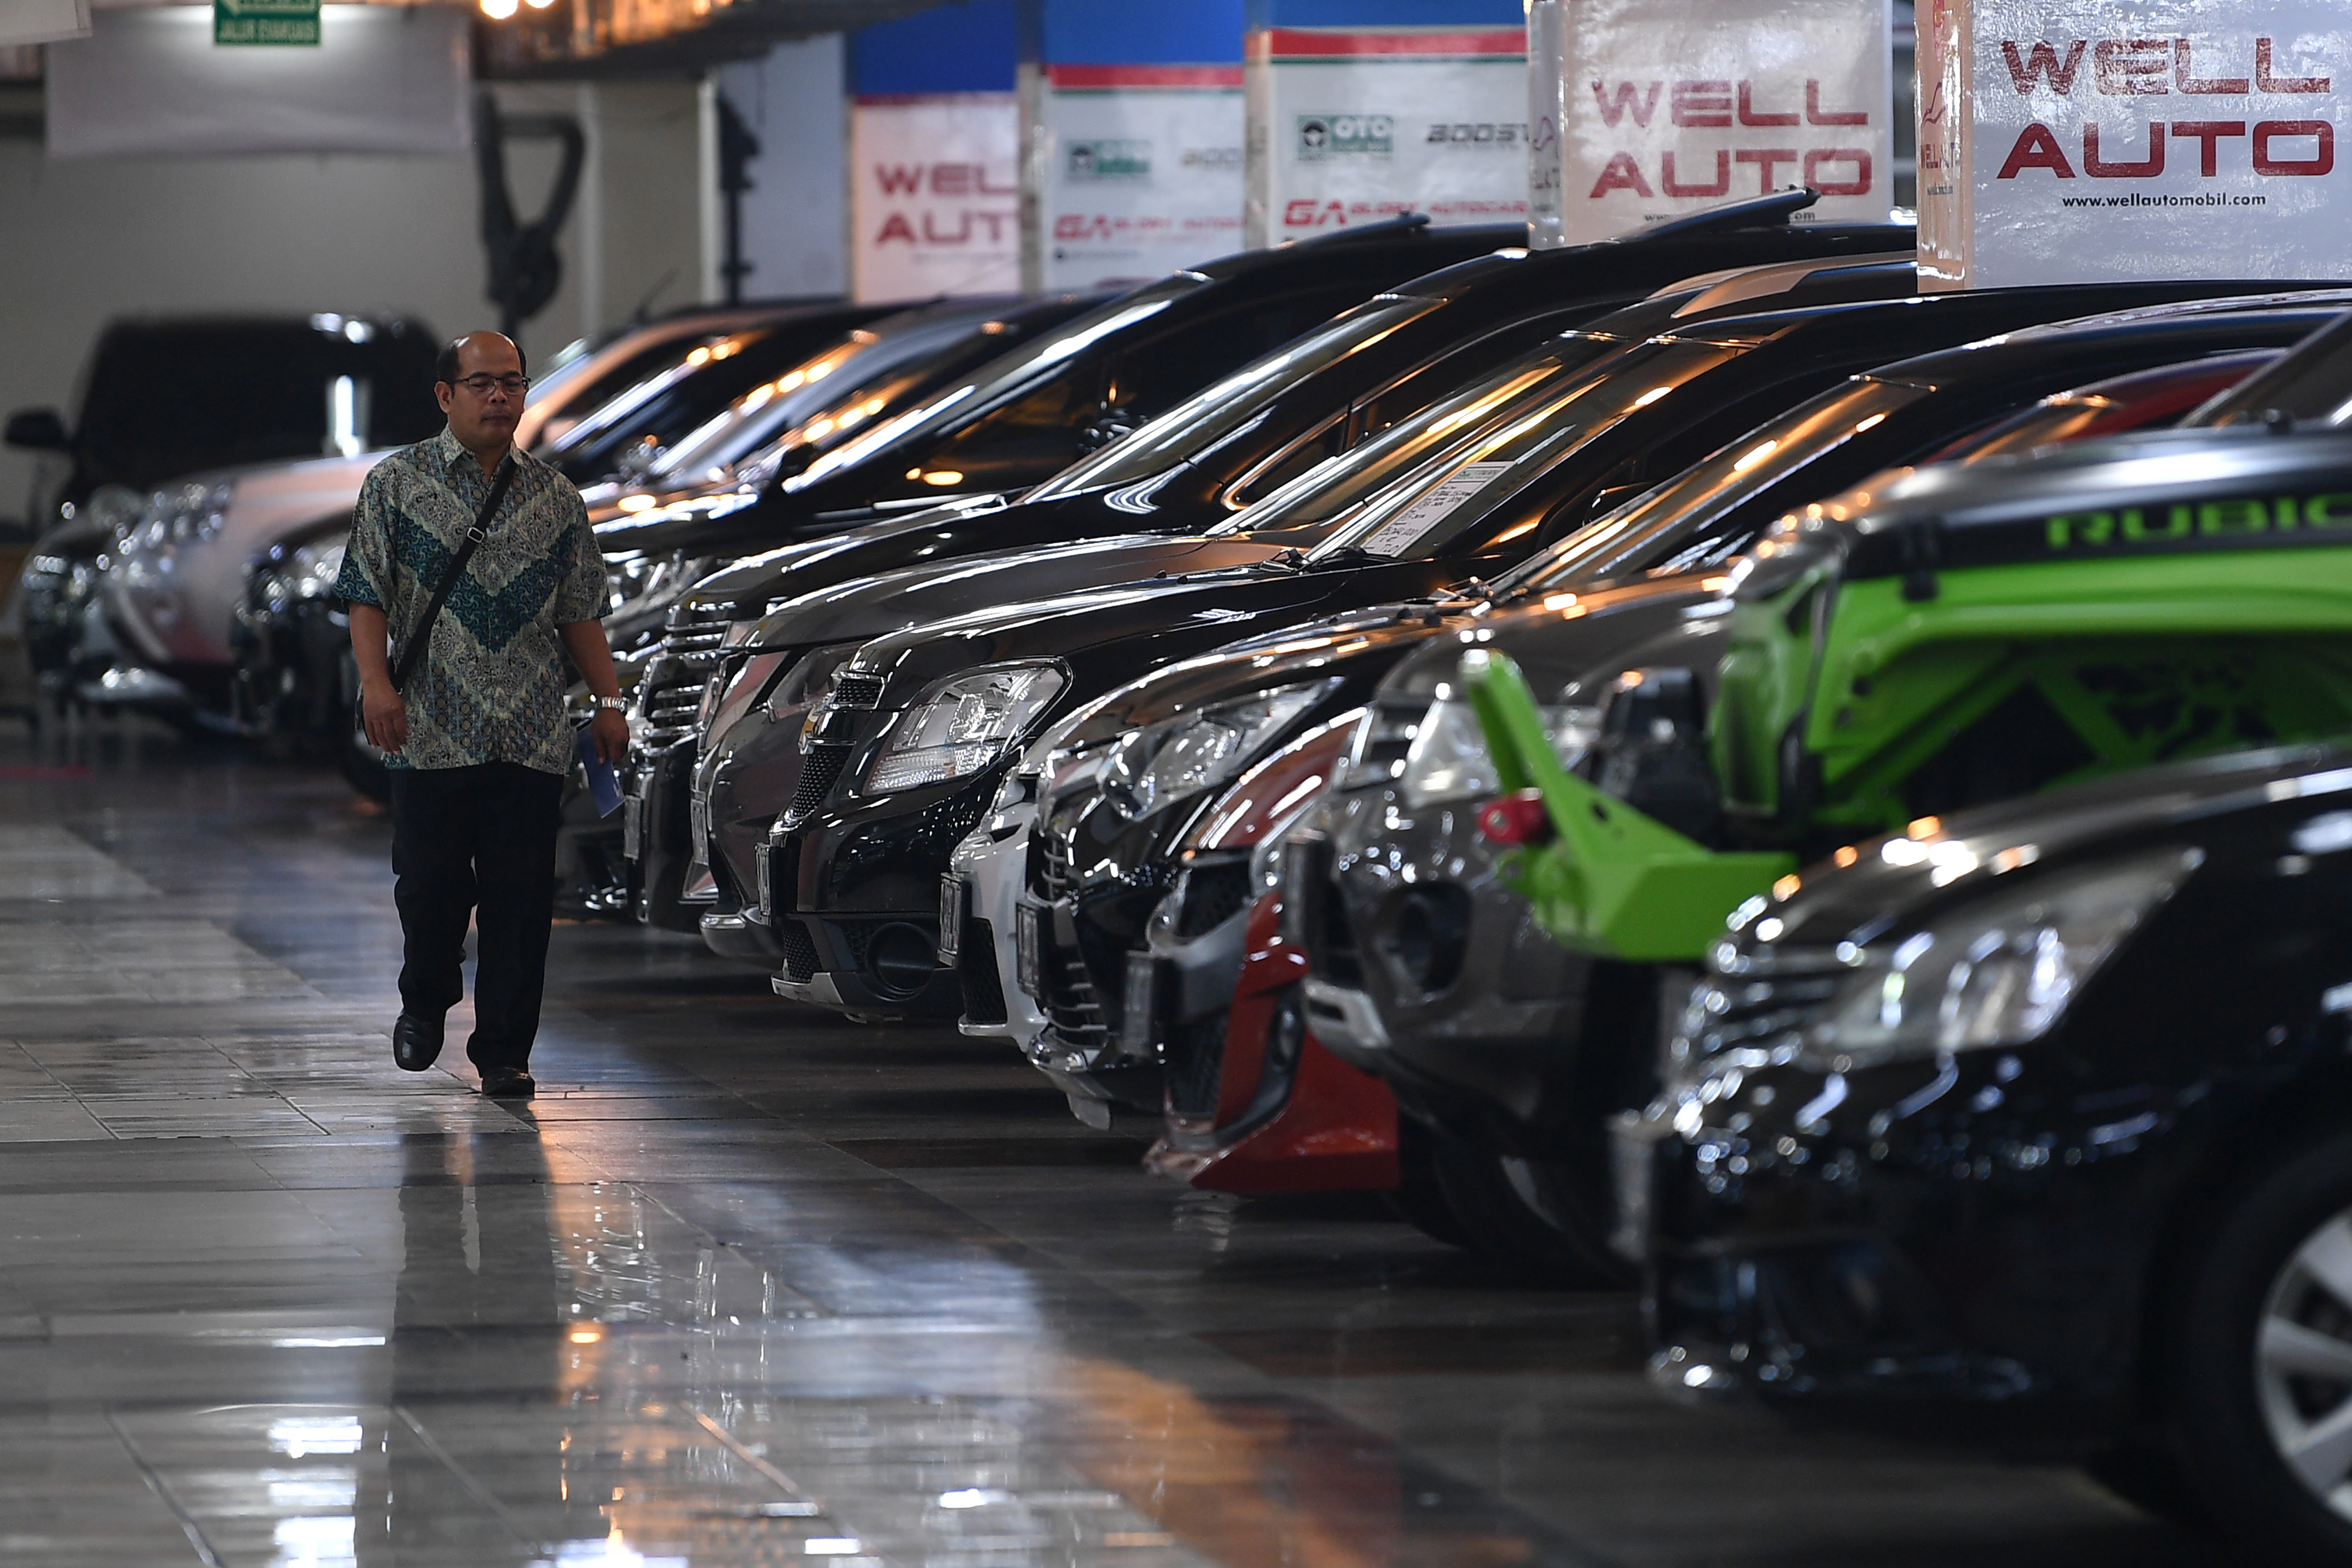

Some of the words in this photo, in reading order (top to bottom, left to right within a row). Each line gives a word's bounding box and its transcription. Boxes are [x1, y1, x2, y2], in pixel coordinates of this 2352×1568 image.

[2004, 37, 2331, 95] WELL
[1591, 79, 1869, 128] WELL
[1589, 148, 1872, 199] AUTO
[1996, 120, 2334, 179] AUTO
[2062, 193, 2266, 208] www.wellautomobil.com
